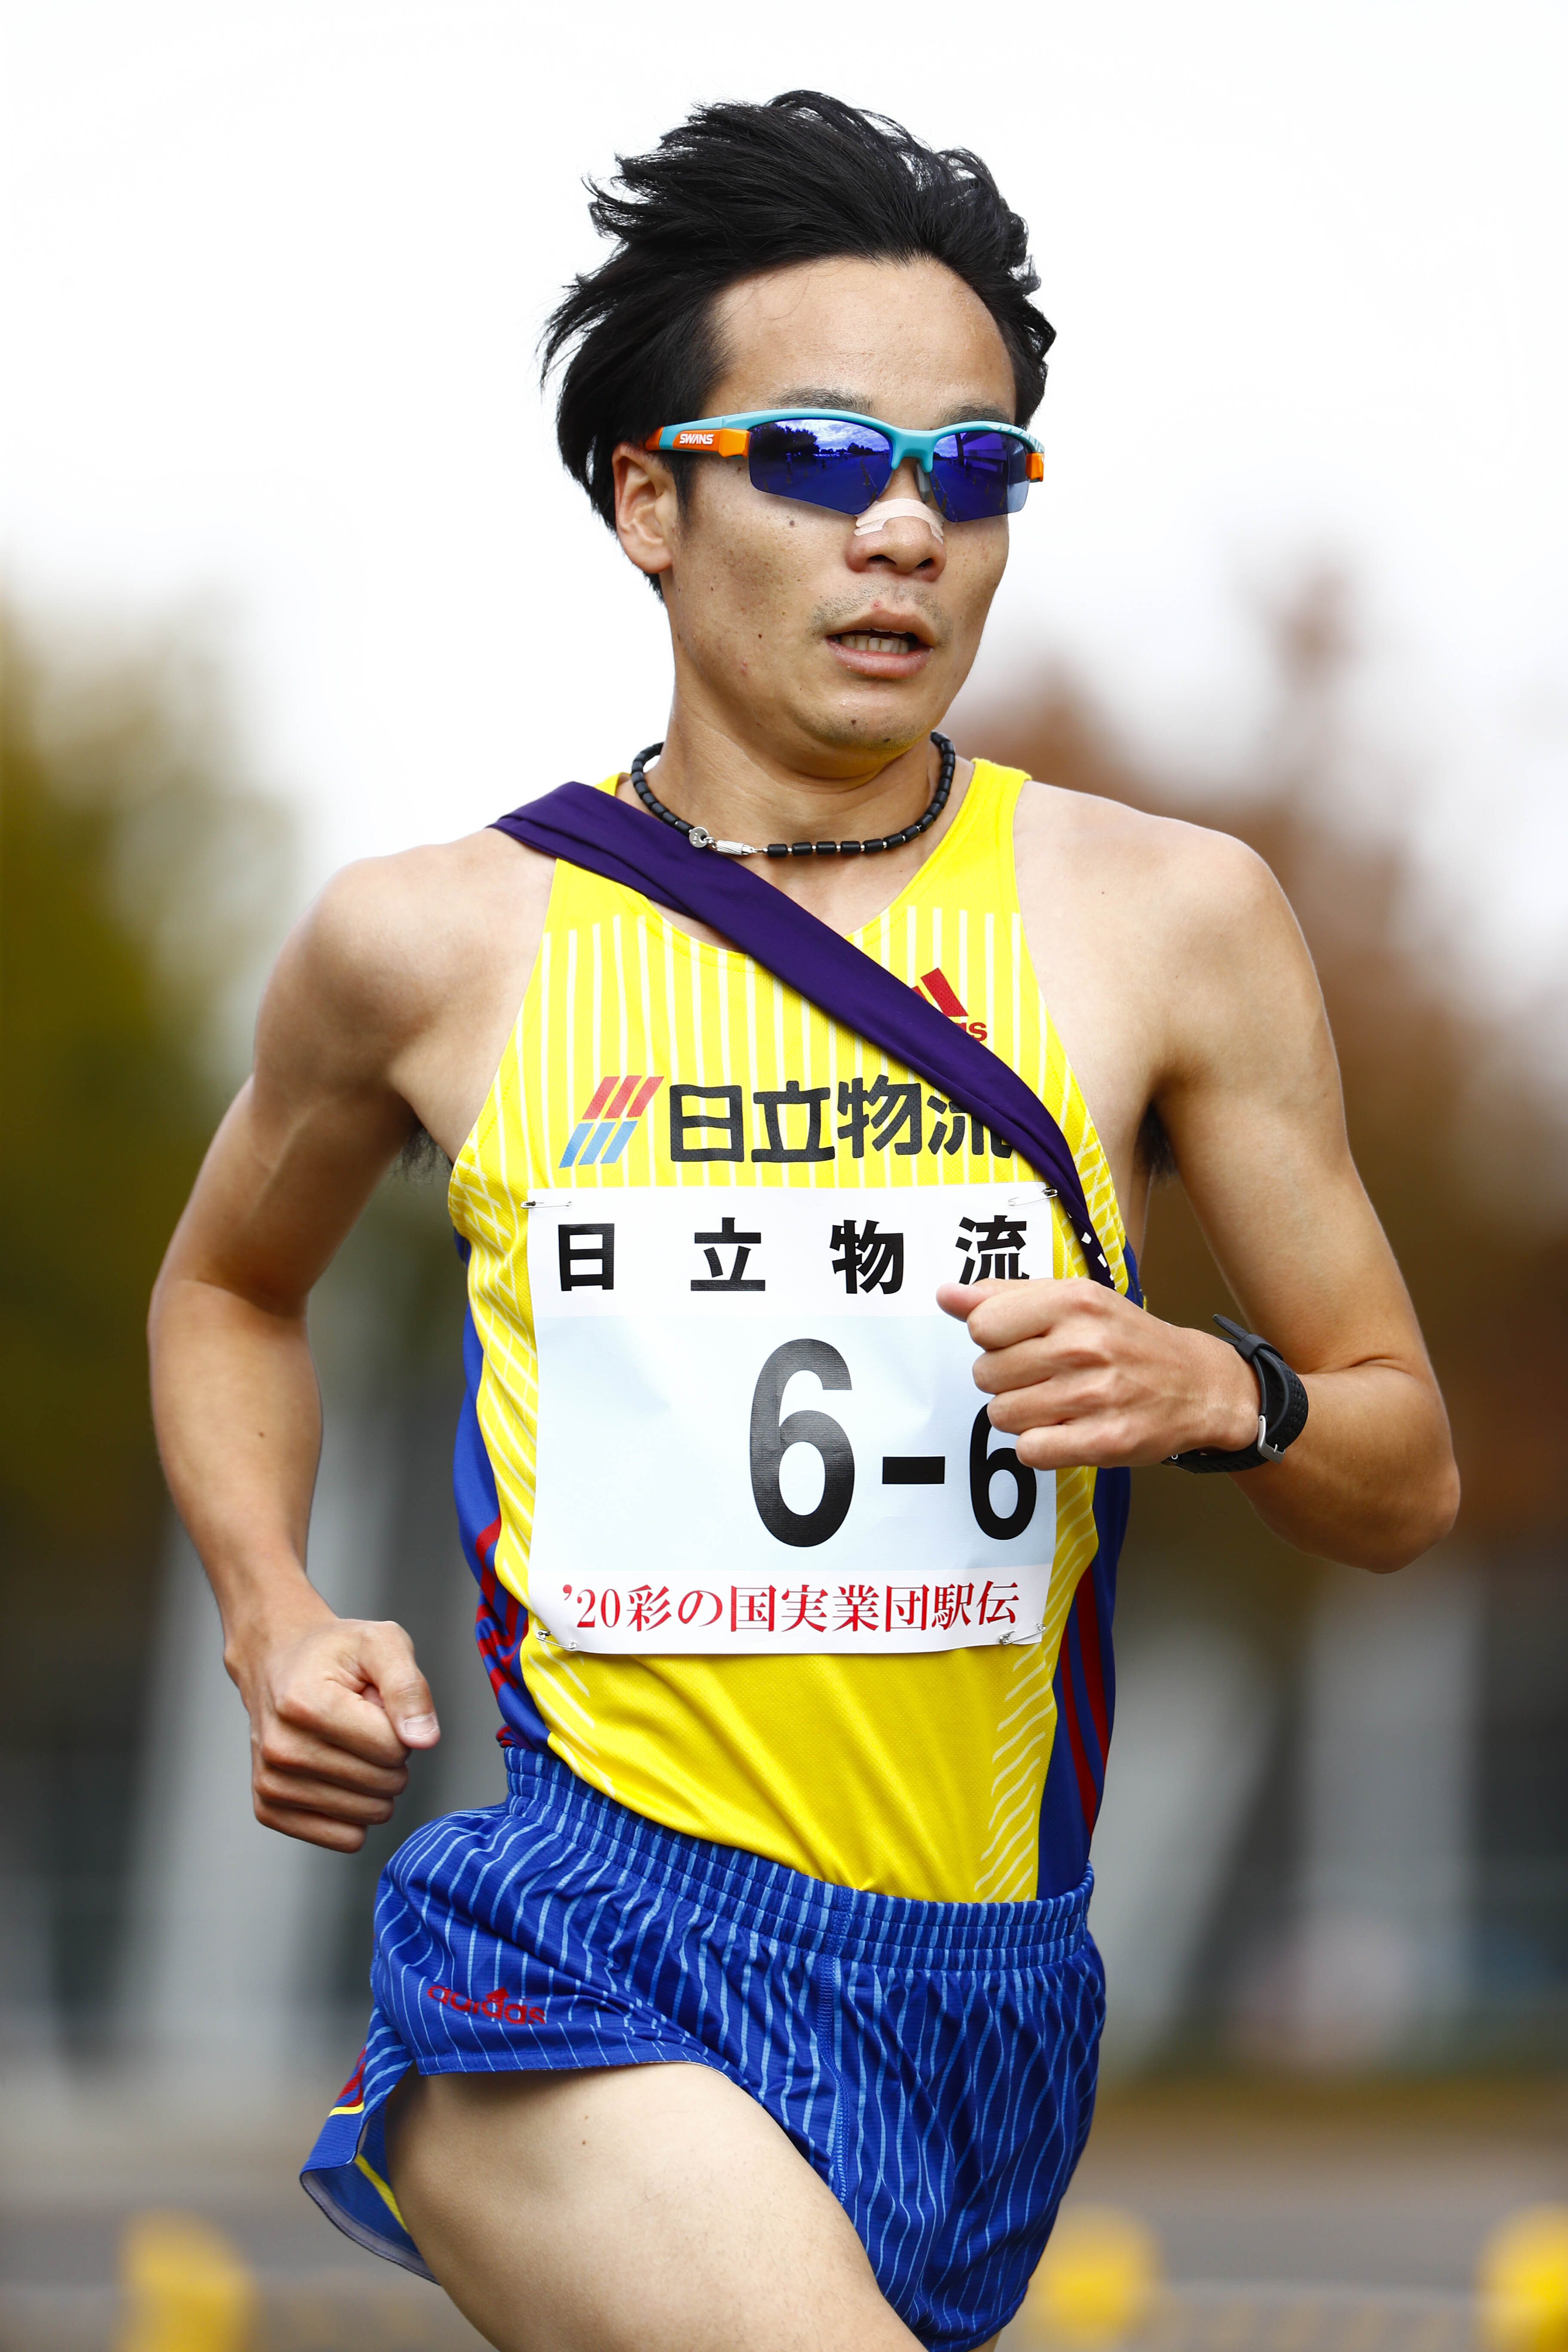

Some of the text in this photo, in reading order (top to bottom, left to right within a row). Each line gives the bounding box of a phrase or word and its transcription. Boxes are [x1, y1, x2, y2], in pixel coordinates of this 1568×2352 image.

[679, 433, 714, 444] SWANS
[558, 1215, 1030, 1294] 日立物流
[750, 1338, 1037, 1547] 6-6
